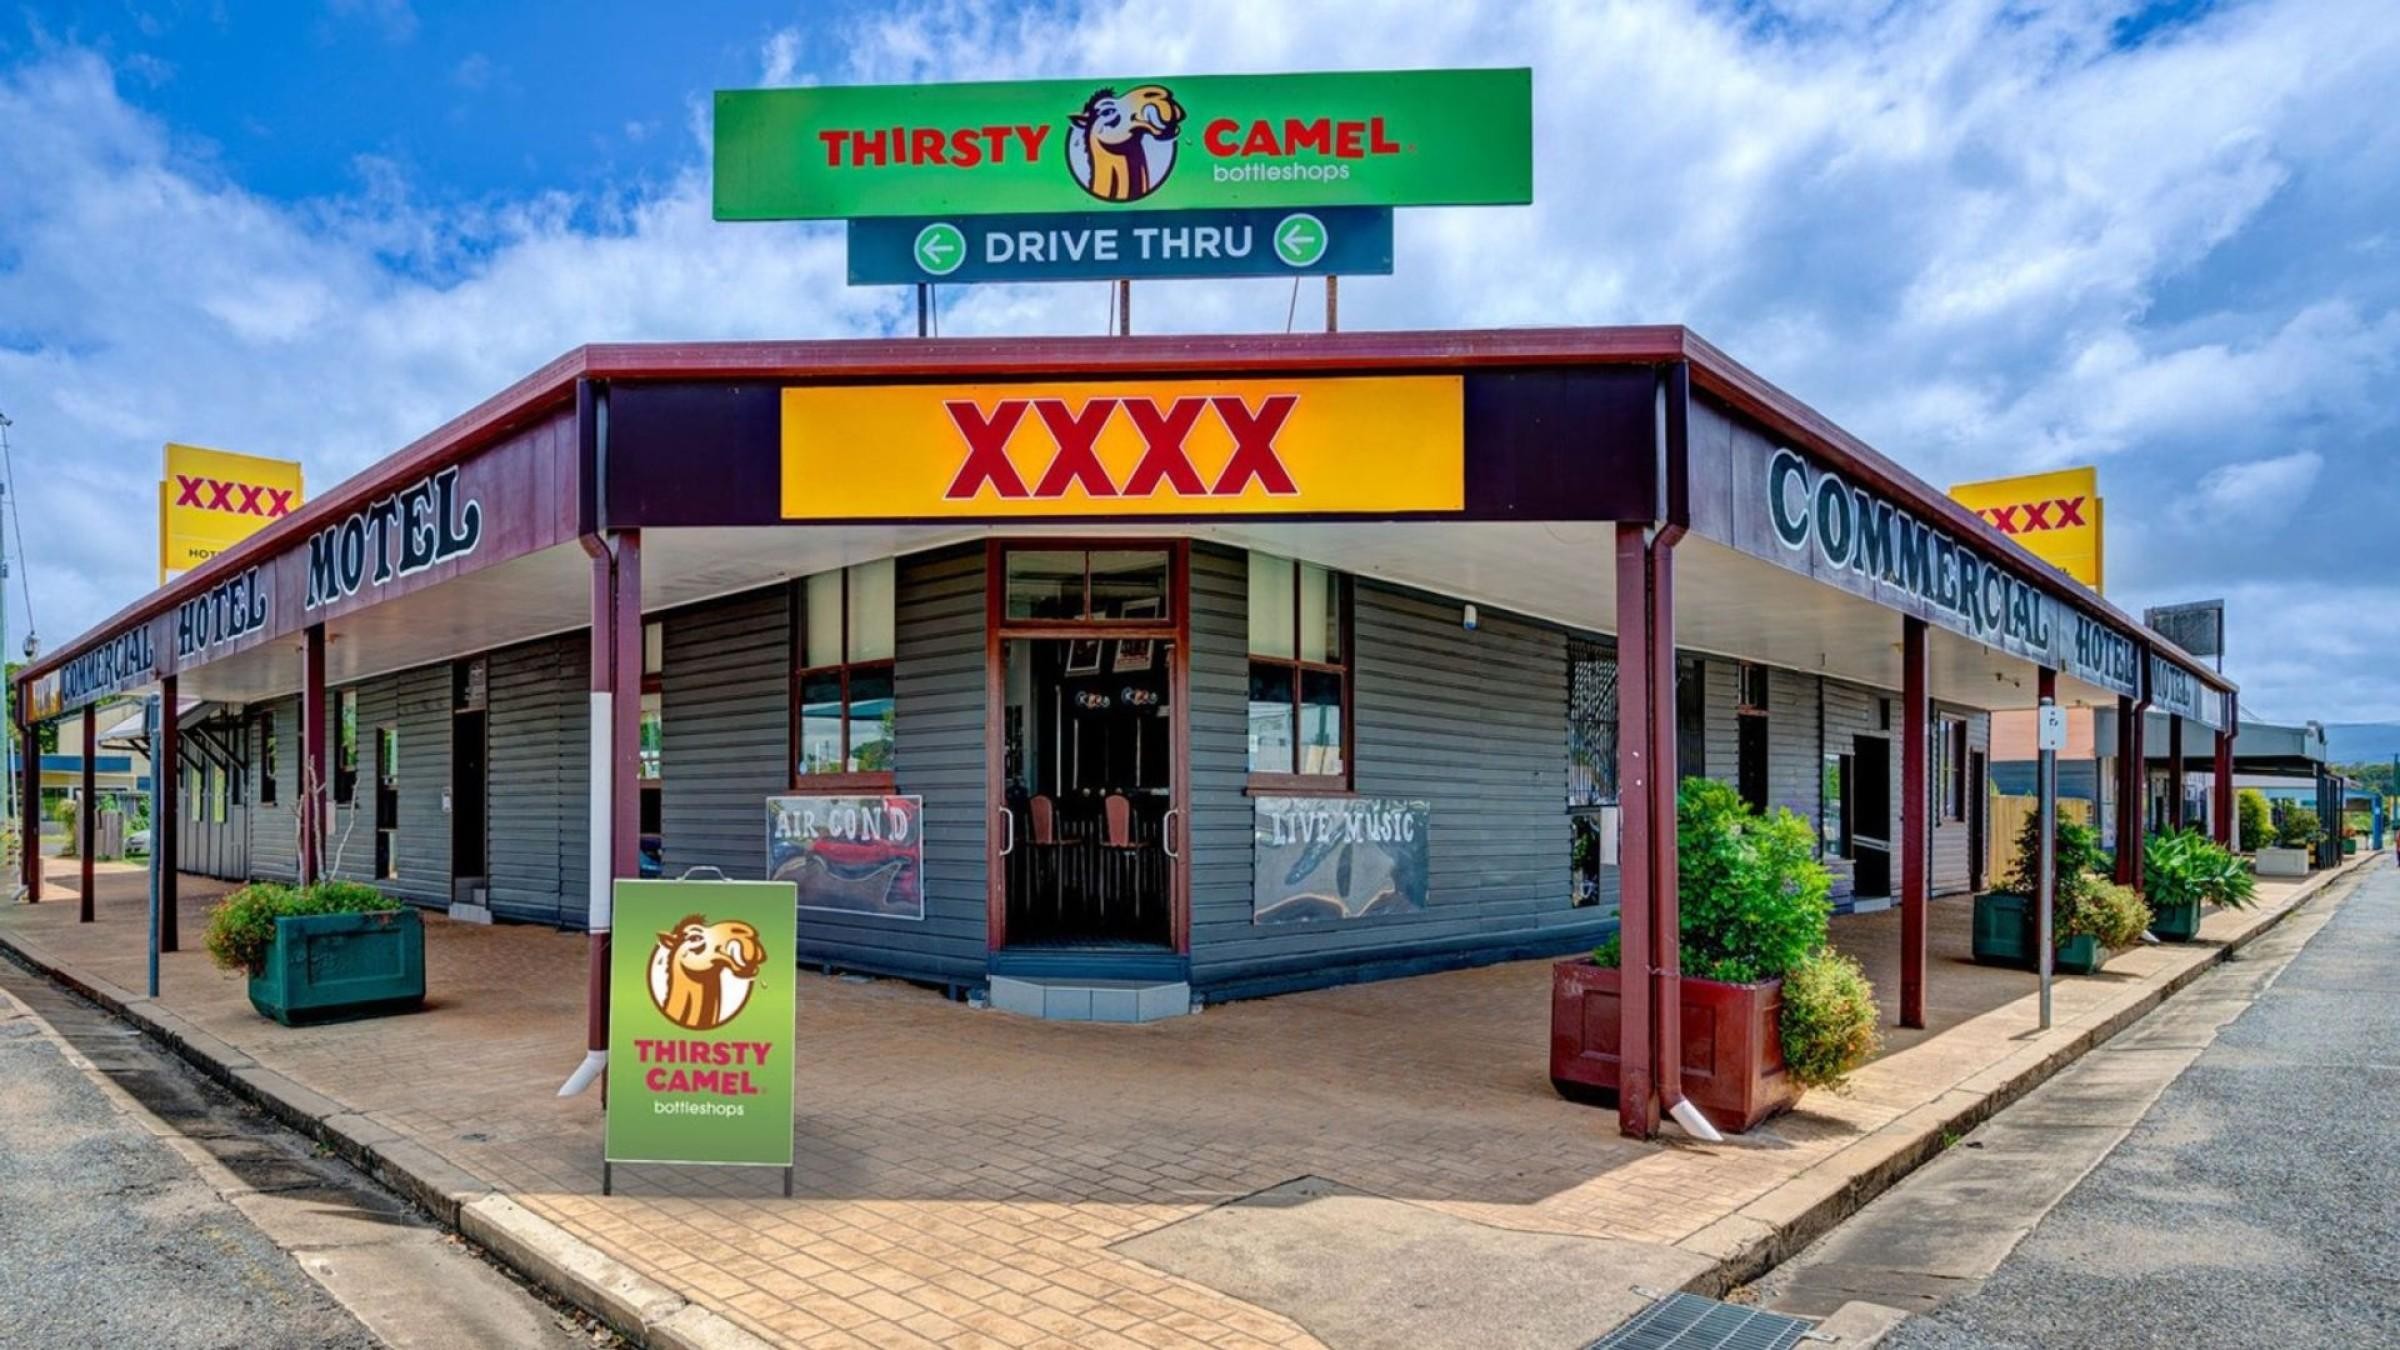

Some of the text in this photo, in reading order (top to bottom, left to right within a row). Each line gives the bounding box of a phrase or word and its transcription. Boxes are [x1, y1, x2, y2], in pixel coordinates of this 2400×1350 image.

[819, 116, 1400, 168] THIRSTY CAMEL
[1213, 161, 1350, 184] bottleshops
[985, 225, 1253, 263] DRIVE THRU
[942, 394, 1301, 500] XXXX
[175, 474, 294, 517] XXXX
[1975, 495, 2086, 535] XXX
[62, 623, 154, 702] COMMERCIAL
[178, 566, 268, 659] HOTEL
[306, 465, 482, 610] MOTEL
[1768, 448, 2190, 706] COMMERCIAL HOTEL MOTEL
[774, 801, 908, 841] AIR CON'D
[1272, 811, 1415, 845] LIVE MUSIC
[633, 1039, 773, 1066] THIRSTY
[645, 1067, 758, 1096] CAMEL
[654, 1101, 745, 1117] bottleshops
